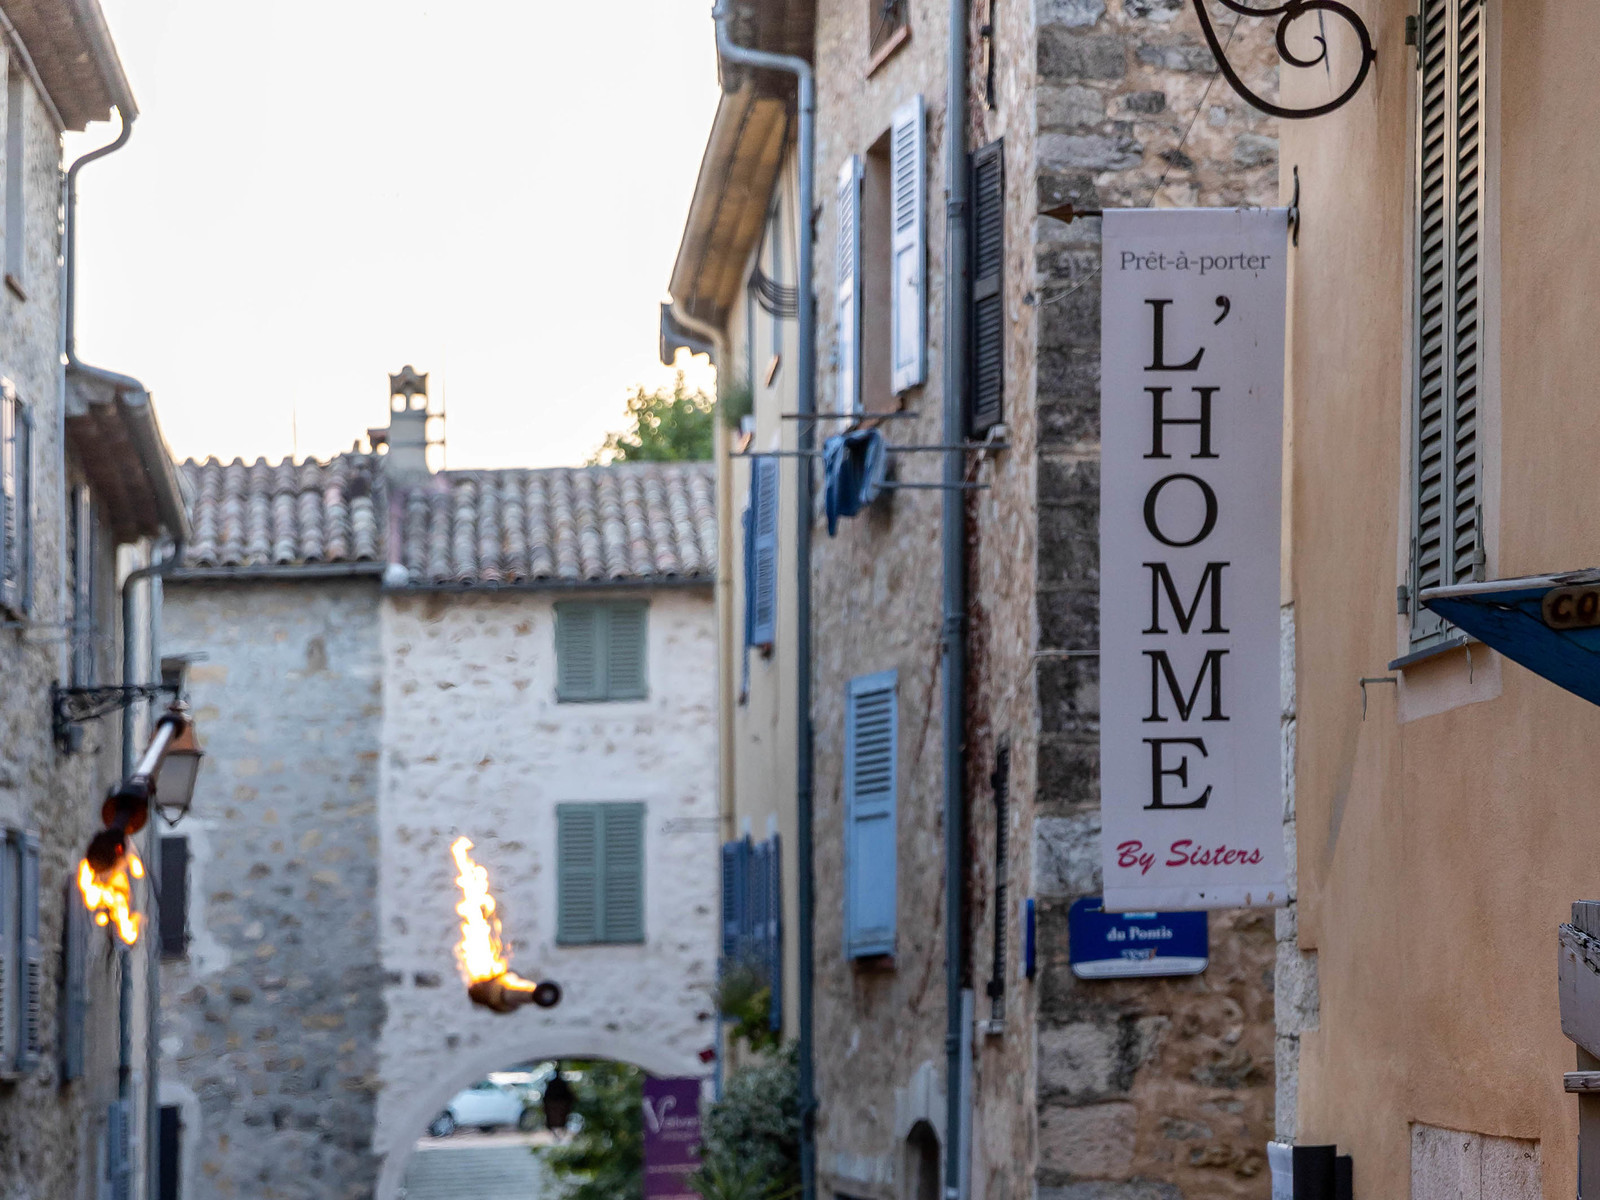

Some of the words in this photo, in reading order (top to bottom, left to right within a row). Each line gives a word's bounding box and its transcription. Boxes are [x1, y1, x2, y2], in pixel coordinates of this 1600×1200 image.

[1120, 250, 1271, 275] Prêt-à-porter
[1141, 294, 1231, 811] L'HOMME
[1116, 839, 1156, 876] By
[1165, 838, 1265, 867] Sisters
[1106, 926, 1126, 942] du
